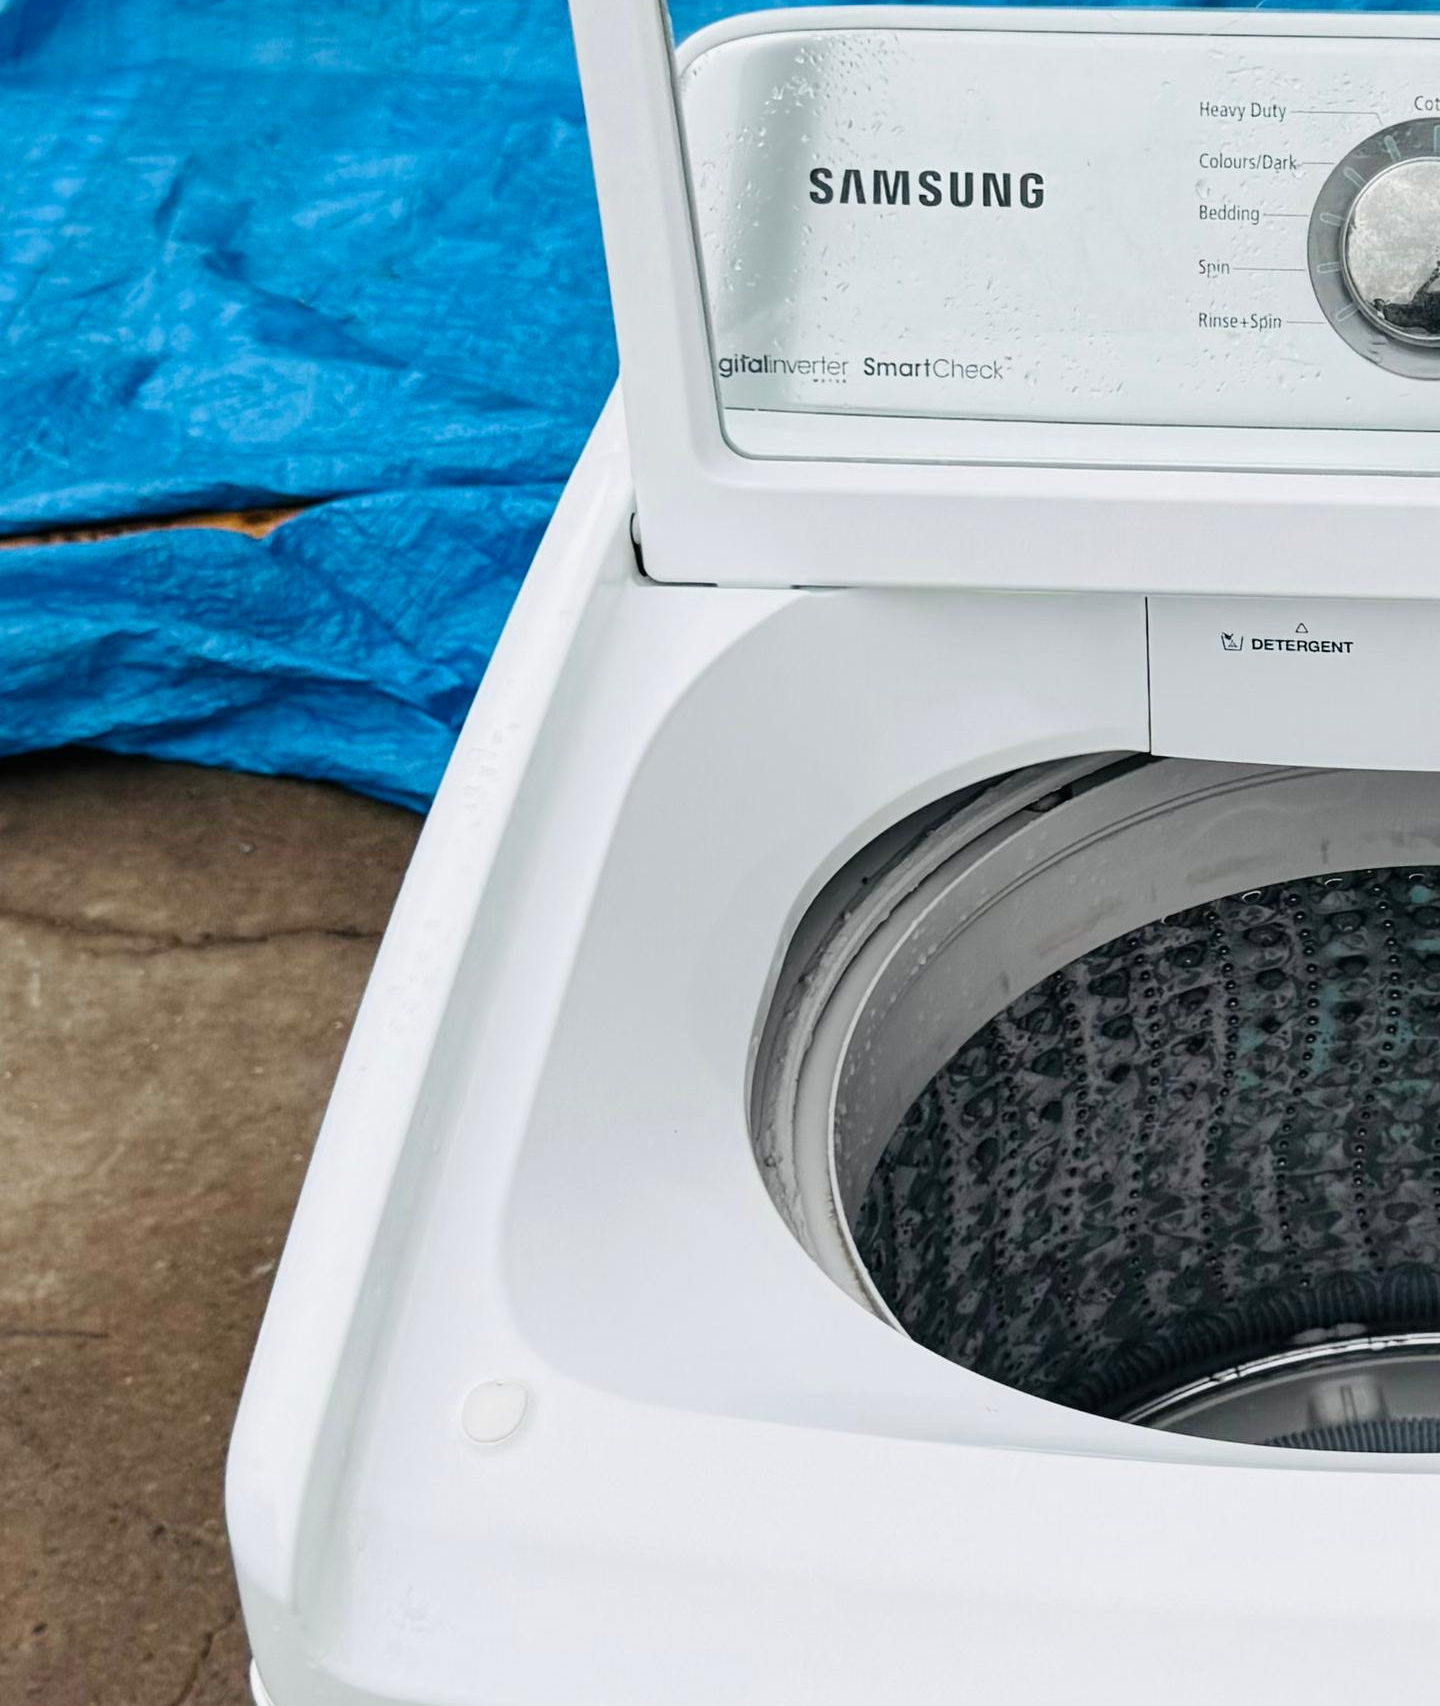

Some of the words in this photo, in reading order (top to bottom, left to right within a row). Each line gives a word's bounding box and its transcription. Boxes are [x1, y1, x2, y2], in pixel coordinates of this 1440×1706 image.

[1199, 101, 1246, 121] Heavy
[1251, 103, 1287, 122] Duty
[1199, 153, 1298, 171] Colours/Dark
[809, 167, 1044, 209] SAMSUNG
[1199, 204, 1260, 225] Bedding
[1198, 259, 1231, 278] Spin
[1198, 312, 1282, 332] Rinse+Spin
[1251, 637, 1354, 654] DETERGENT
